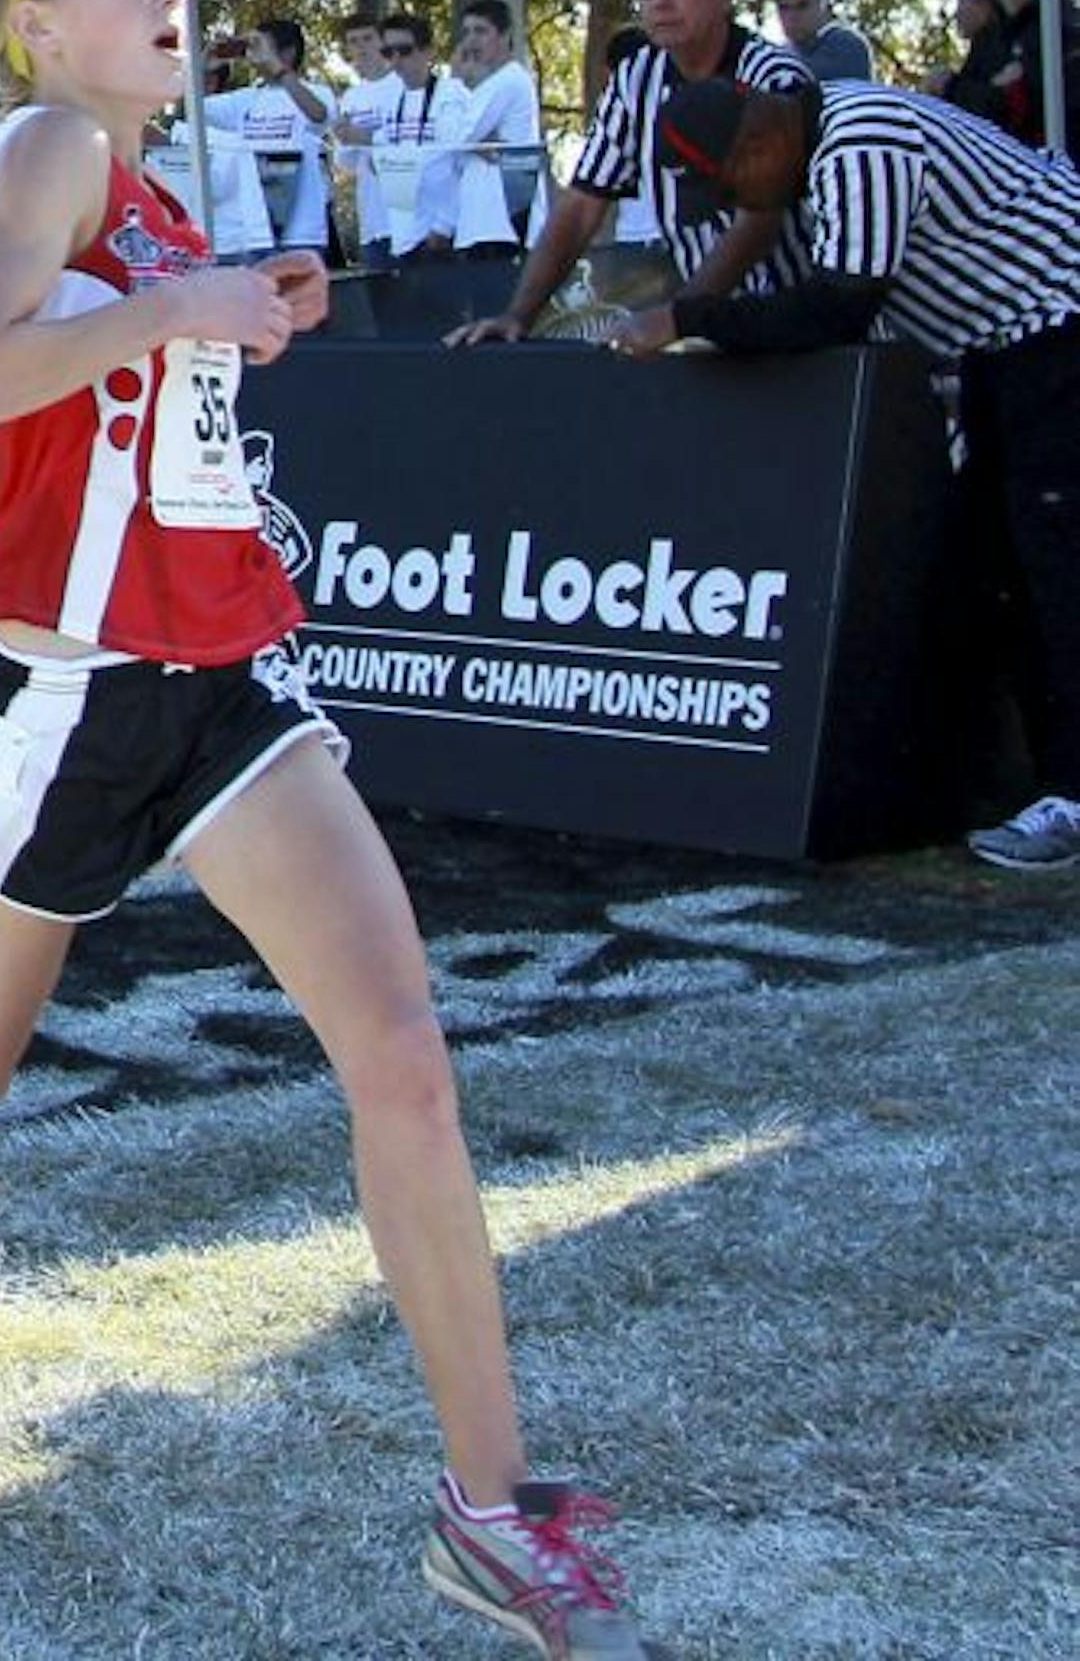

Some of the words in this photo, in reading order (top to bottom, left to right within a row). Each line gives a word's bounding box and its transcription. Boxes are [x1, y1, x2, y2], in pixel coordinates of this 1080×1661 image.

[192, 373, 231, 443] 35
[314, 521, 475, 616] Foot
[501, 530, 788, 642] Locker
[301, 644, 456, 697] COUNTRY
[463, 657, 771, 731] CHAMPIONSHIPS
